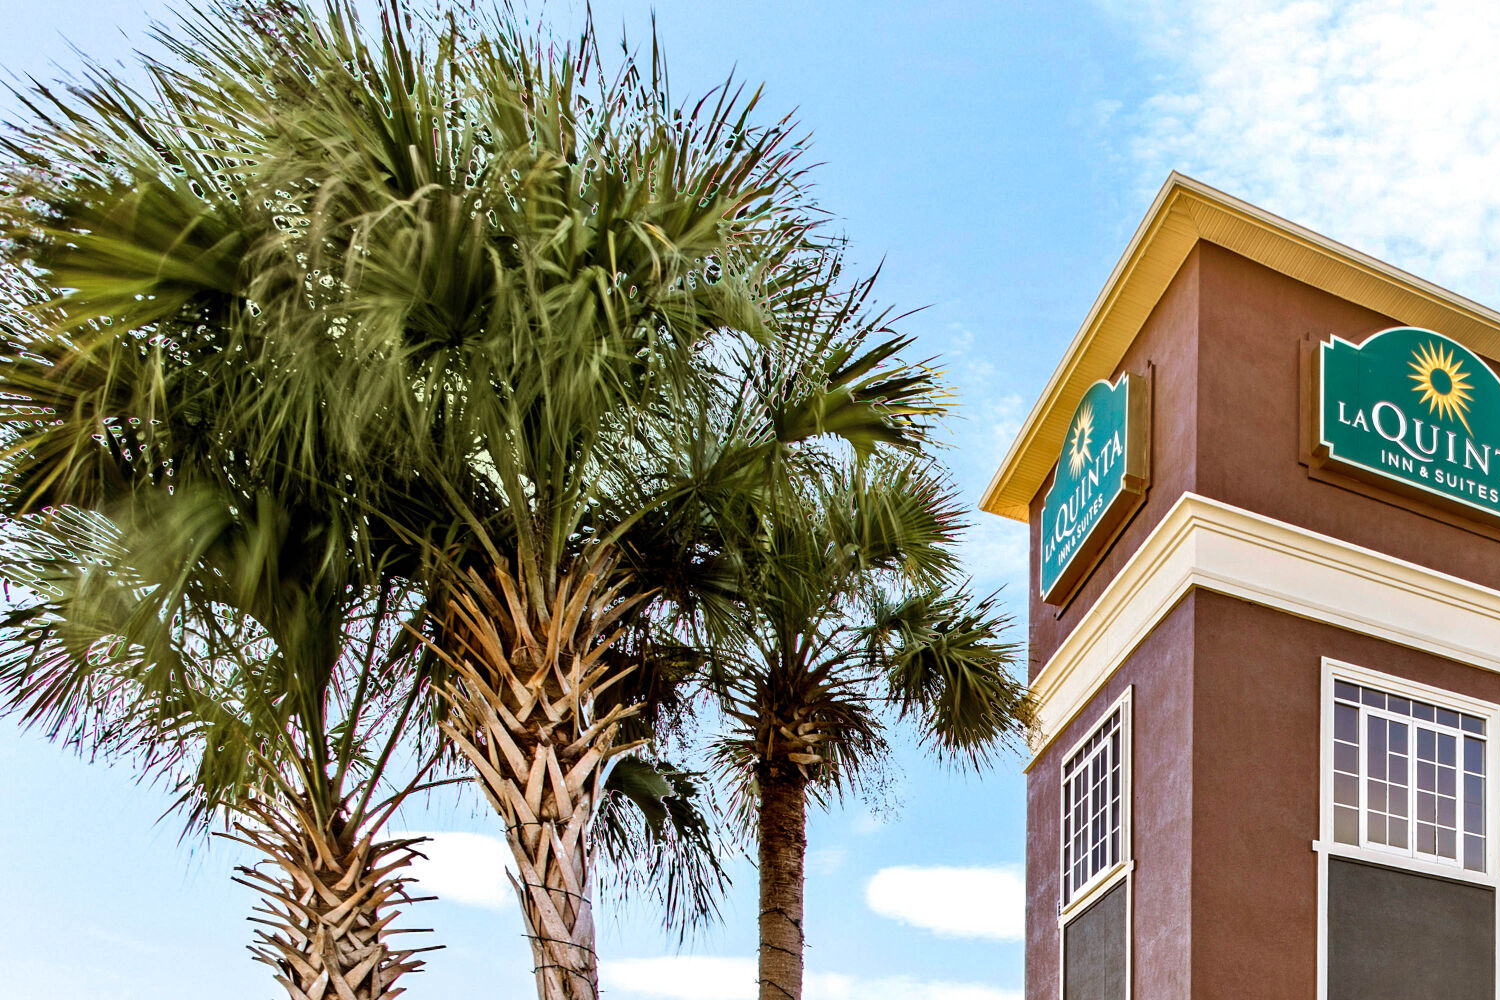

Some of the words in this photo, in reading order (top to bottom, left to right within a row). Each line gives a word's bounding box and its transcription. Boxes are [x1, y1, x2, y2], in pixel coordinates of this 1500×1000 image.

[1338, 401, 1370, 432] LA
[1045, 536, 1056, 563] LA
[1055, 430, 1122, 542] QUINTA
[1381, 449, 1413, 473] INN
[1419, 465, 1429, 478] &
[1435, 469, 1499, 503] SUITES
[1058, 541, 1071, 567] INN
[1071, 537, 1077, 547] &
[1077, 493, 1103, 537] SUITES
